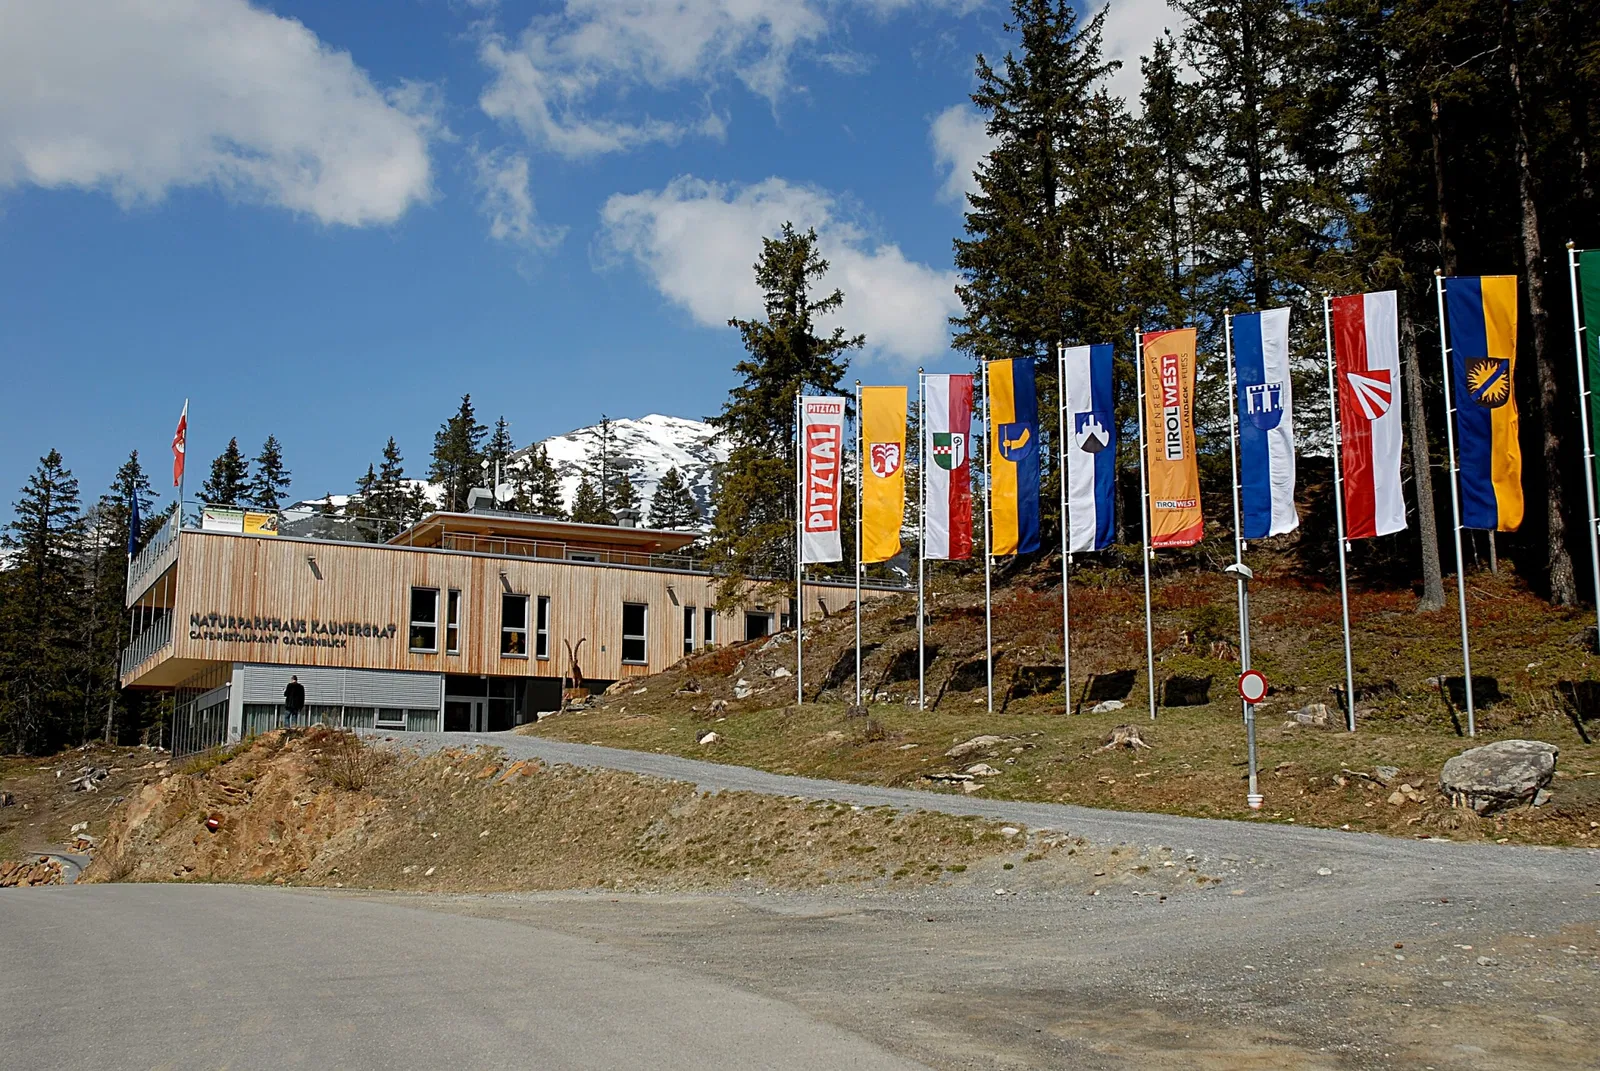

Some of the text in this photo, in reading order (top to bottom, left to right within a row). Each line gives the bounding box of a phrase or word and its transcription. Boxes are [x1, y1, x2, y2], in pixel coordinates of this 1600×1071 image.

[1180, 352, 1188, 379] FLIESS
[808, 404, 839, 413] PITZTAL
[1152, 356, 1163, 461] FERIENREGION
[1182, 386, 1190, 428] LANDECK
[808, 427, 836, 529] PITZTAL
[190, 612, 397, 640] NATURPARKHAUS KAUNERGRAT
[283, 634, 347, 648] GACHENBLICK
